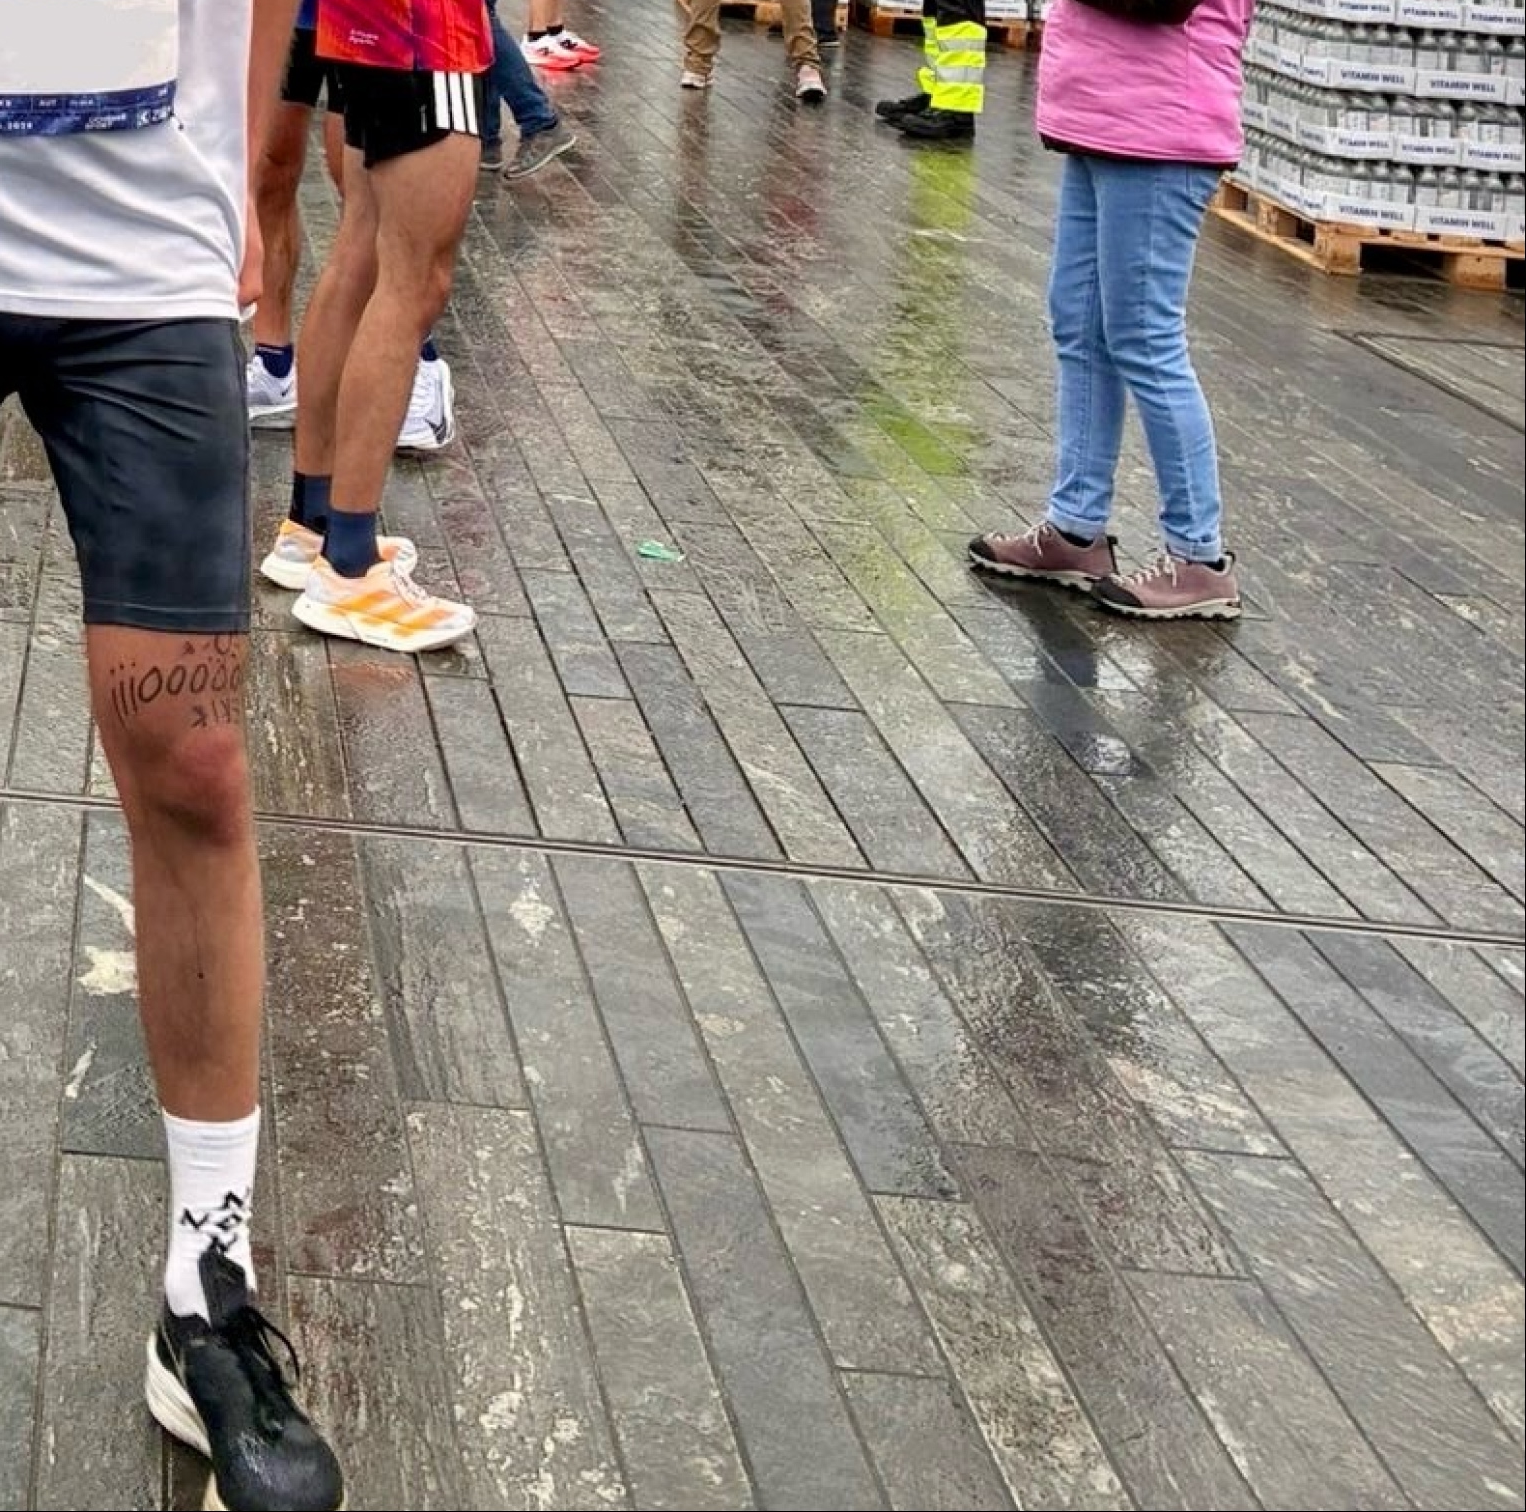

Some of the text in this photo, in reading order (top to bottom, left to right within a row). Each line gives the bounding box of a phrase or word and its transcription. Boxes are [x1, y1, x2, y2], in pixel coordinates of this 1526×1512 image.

[1341, 70, 1405, 85] VITAMIN WELL
[1430, 79, 1496, 94] VITAMIN WELL
[1339, 206, 1404, 222] VITAMIN WELL
[1429, 217, 1496, 231] VITAMIN WELL
